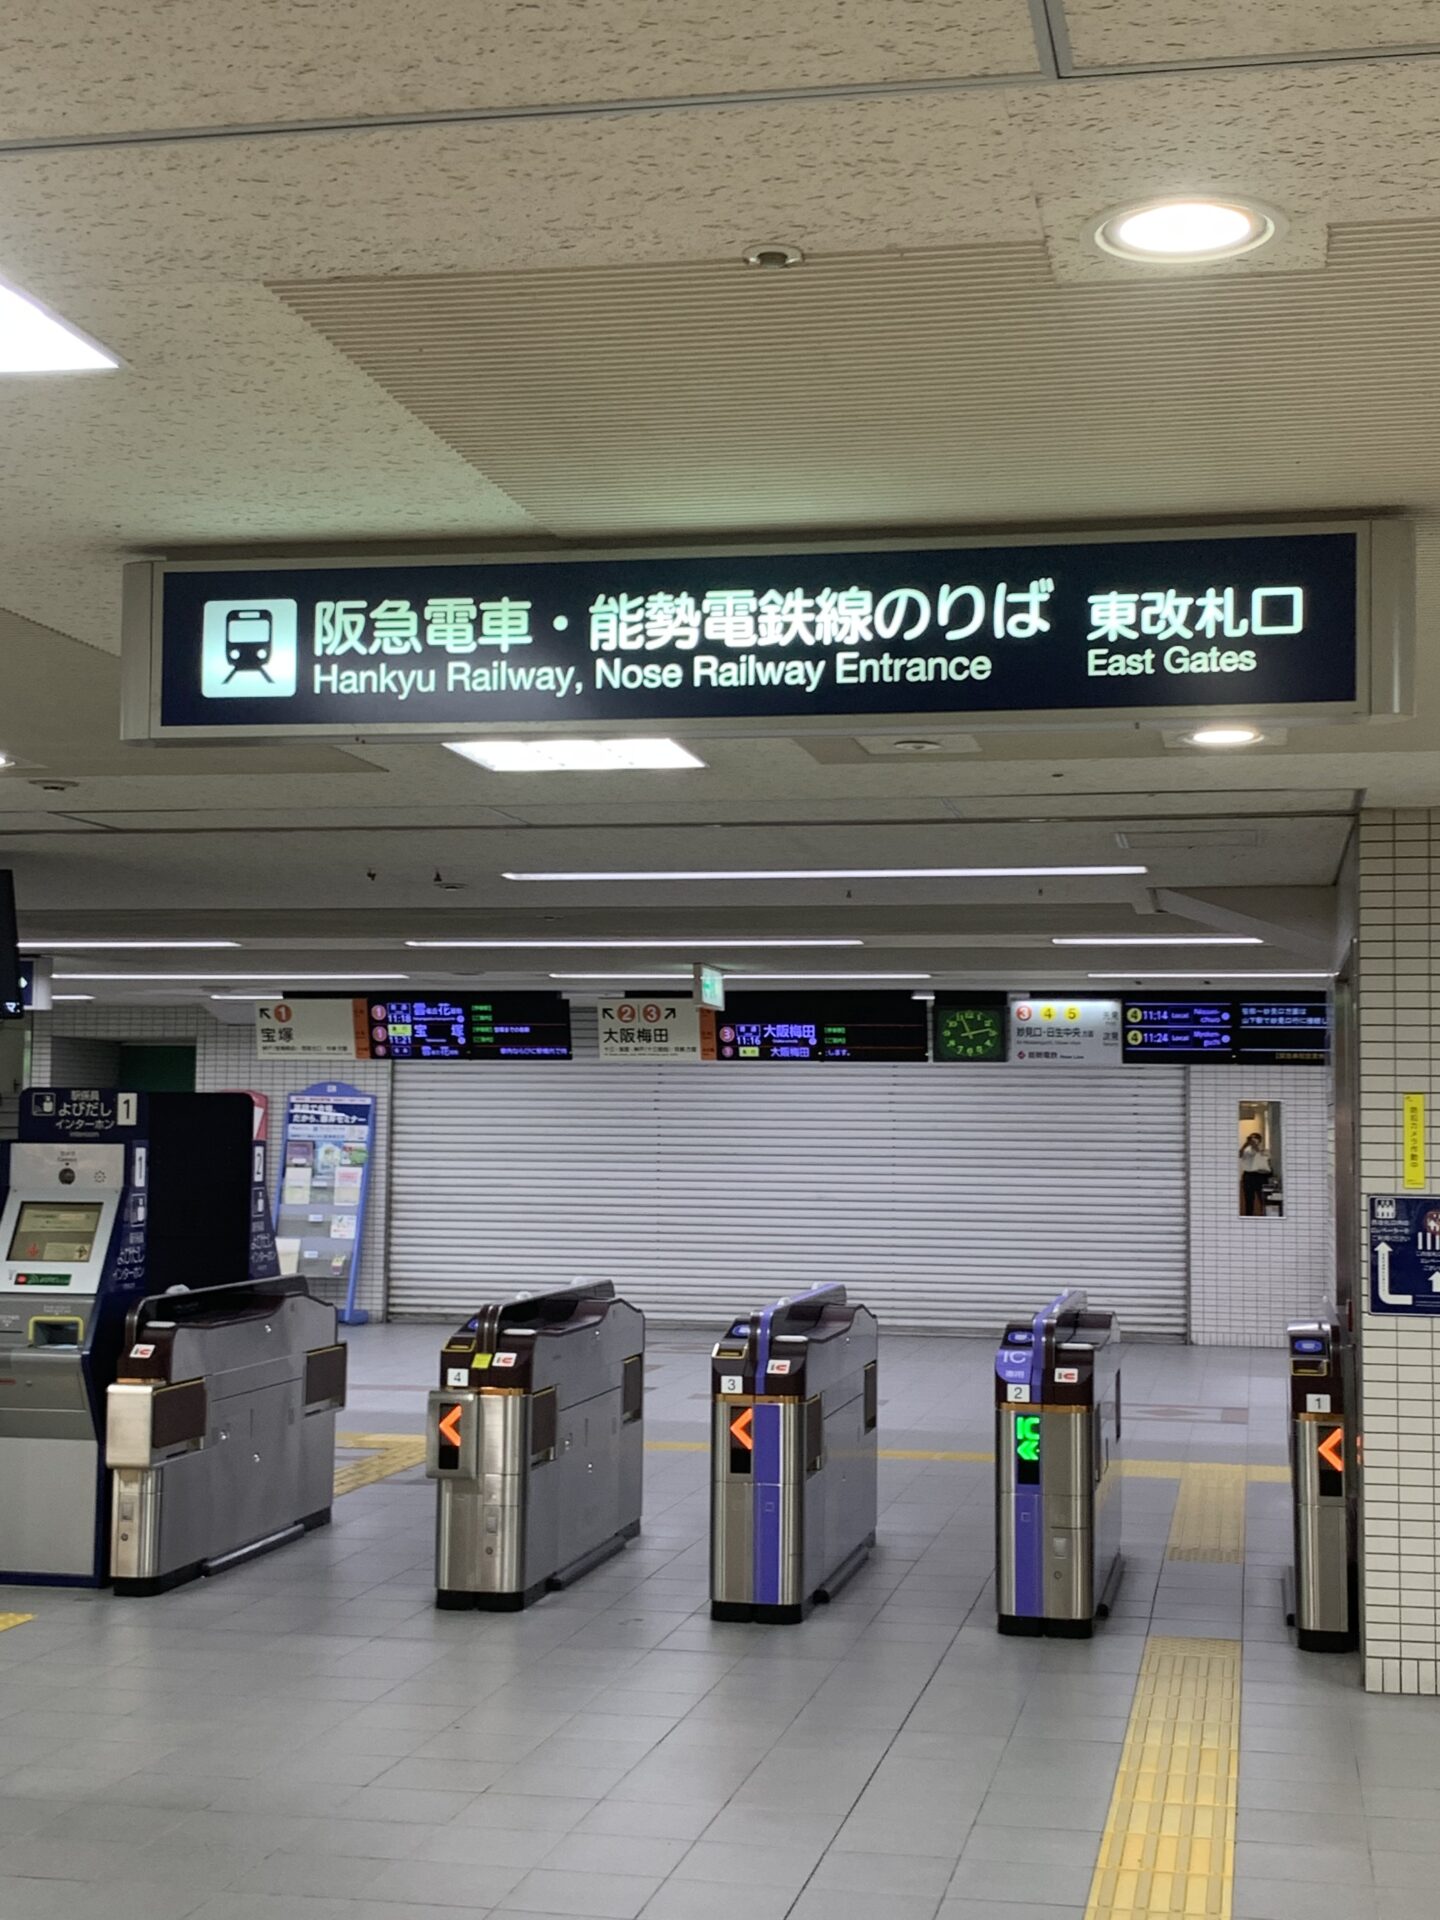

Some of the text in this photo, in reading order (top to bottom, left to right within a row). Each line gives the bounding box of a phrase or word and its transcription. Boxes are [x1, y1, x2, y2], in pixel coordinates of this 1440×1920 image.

[1087, 586, 1303, 643] 東改札口
[1088, 645, 1257, 678] East Gates
[313, 650, 992, 700] Hankyu Railway, Nose Railway Entrance
[1143, 1010, 1168, 1020] 11:14
[261, 1028, 293, 1043] 宝塚
[603, 1028, 669, 1044] 大阪梅田
[763, 1024, 815, 1038] 大阪梅田
[1143, 1033, 1168, 1043] 11:24
[737, 1036, 761, 1045] 11:16
[58, 1102, 112, 1117] よびだし
[55, 1119, 115, 1129] インターホン
[1003, 1351, 1027, 1363] IC
[1017, 1417, 1041, 1440] IC
